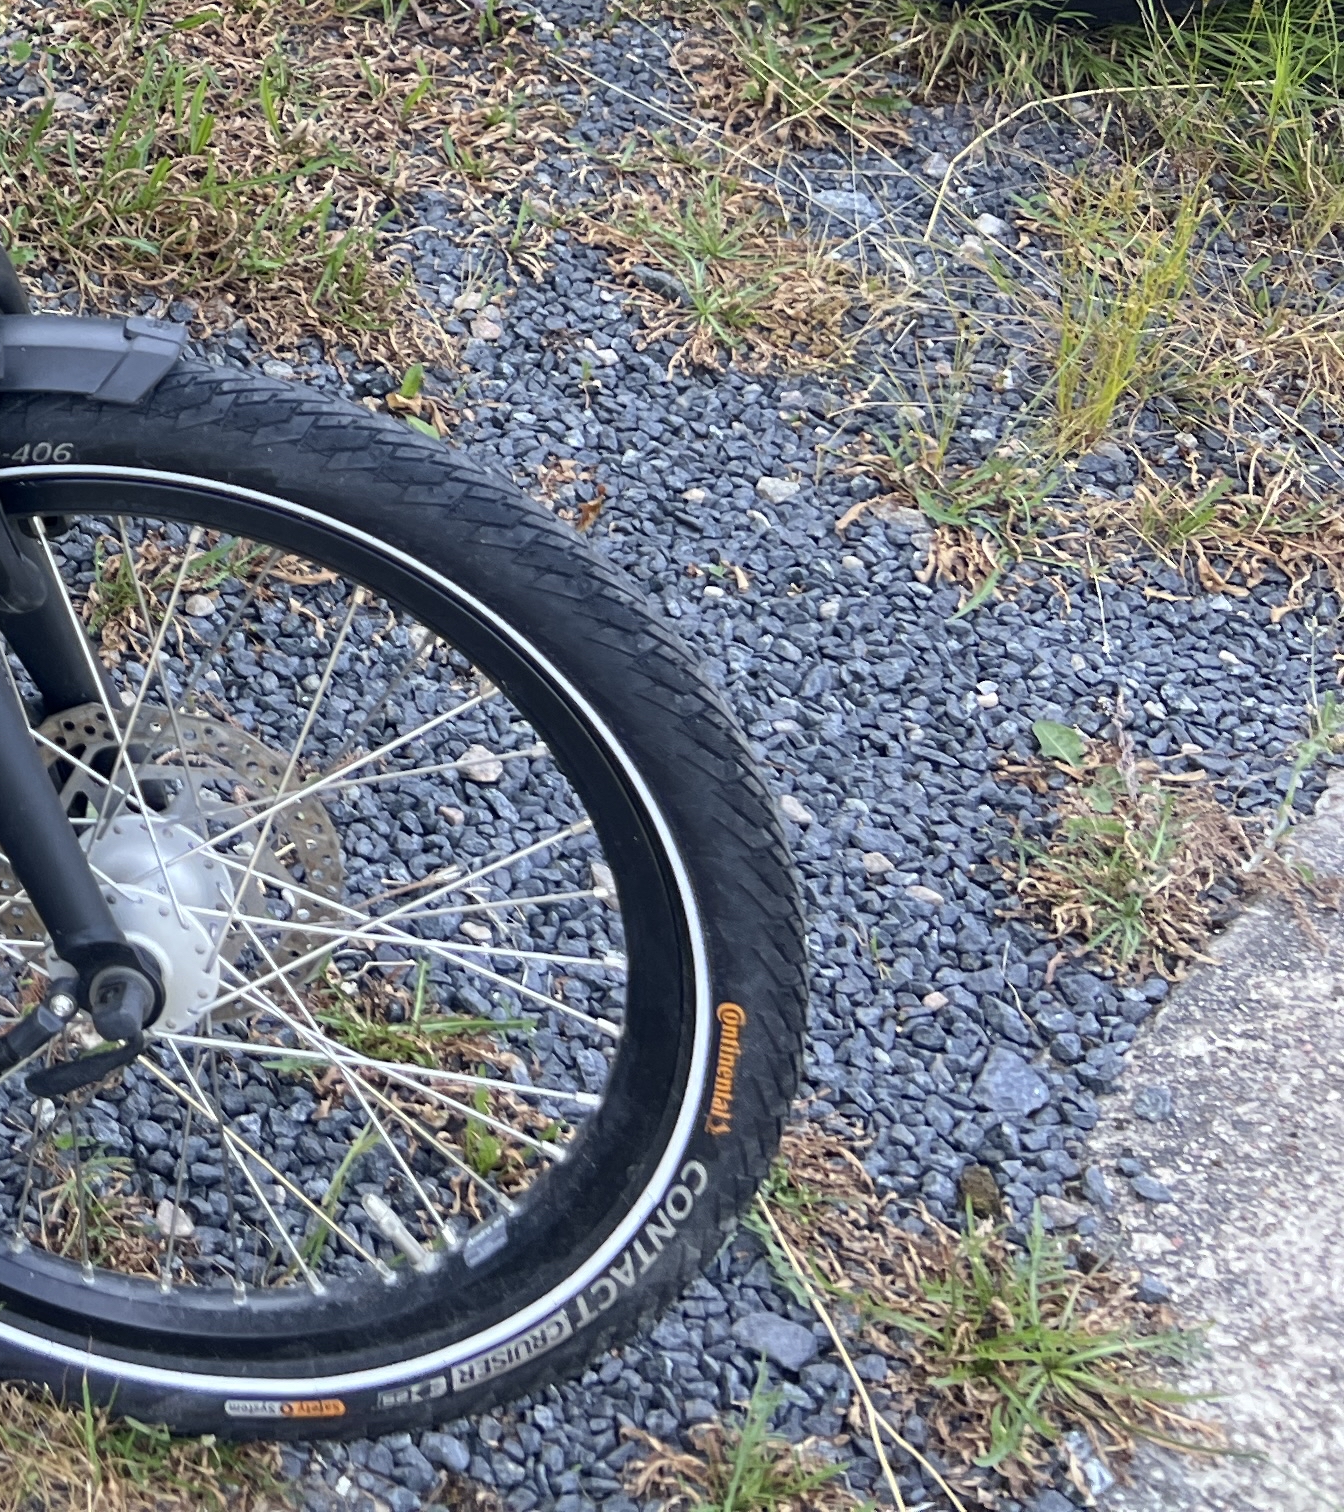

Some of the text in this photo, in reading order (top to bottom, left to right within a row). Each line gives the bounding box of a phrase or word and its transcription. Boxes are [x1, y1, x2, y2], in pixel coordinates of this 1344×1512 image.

[709, 1002, 747, 1121] Continental
[567, 1160, 709, 1332] CONTACT
[455, 1319, 567, 1386] CRUISER
